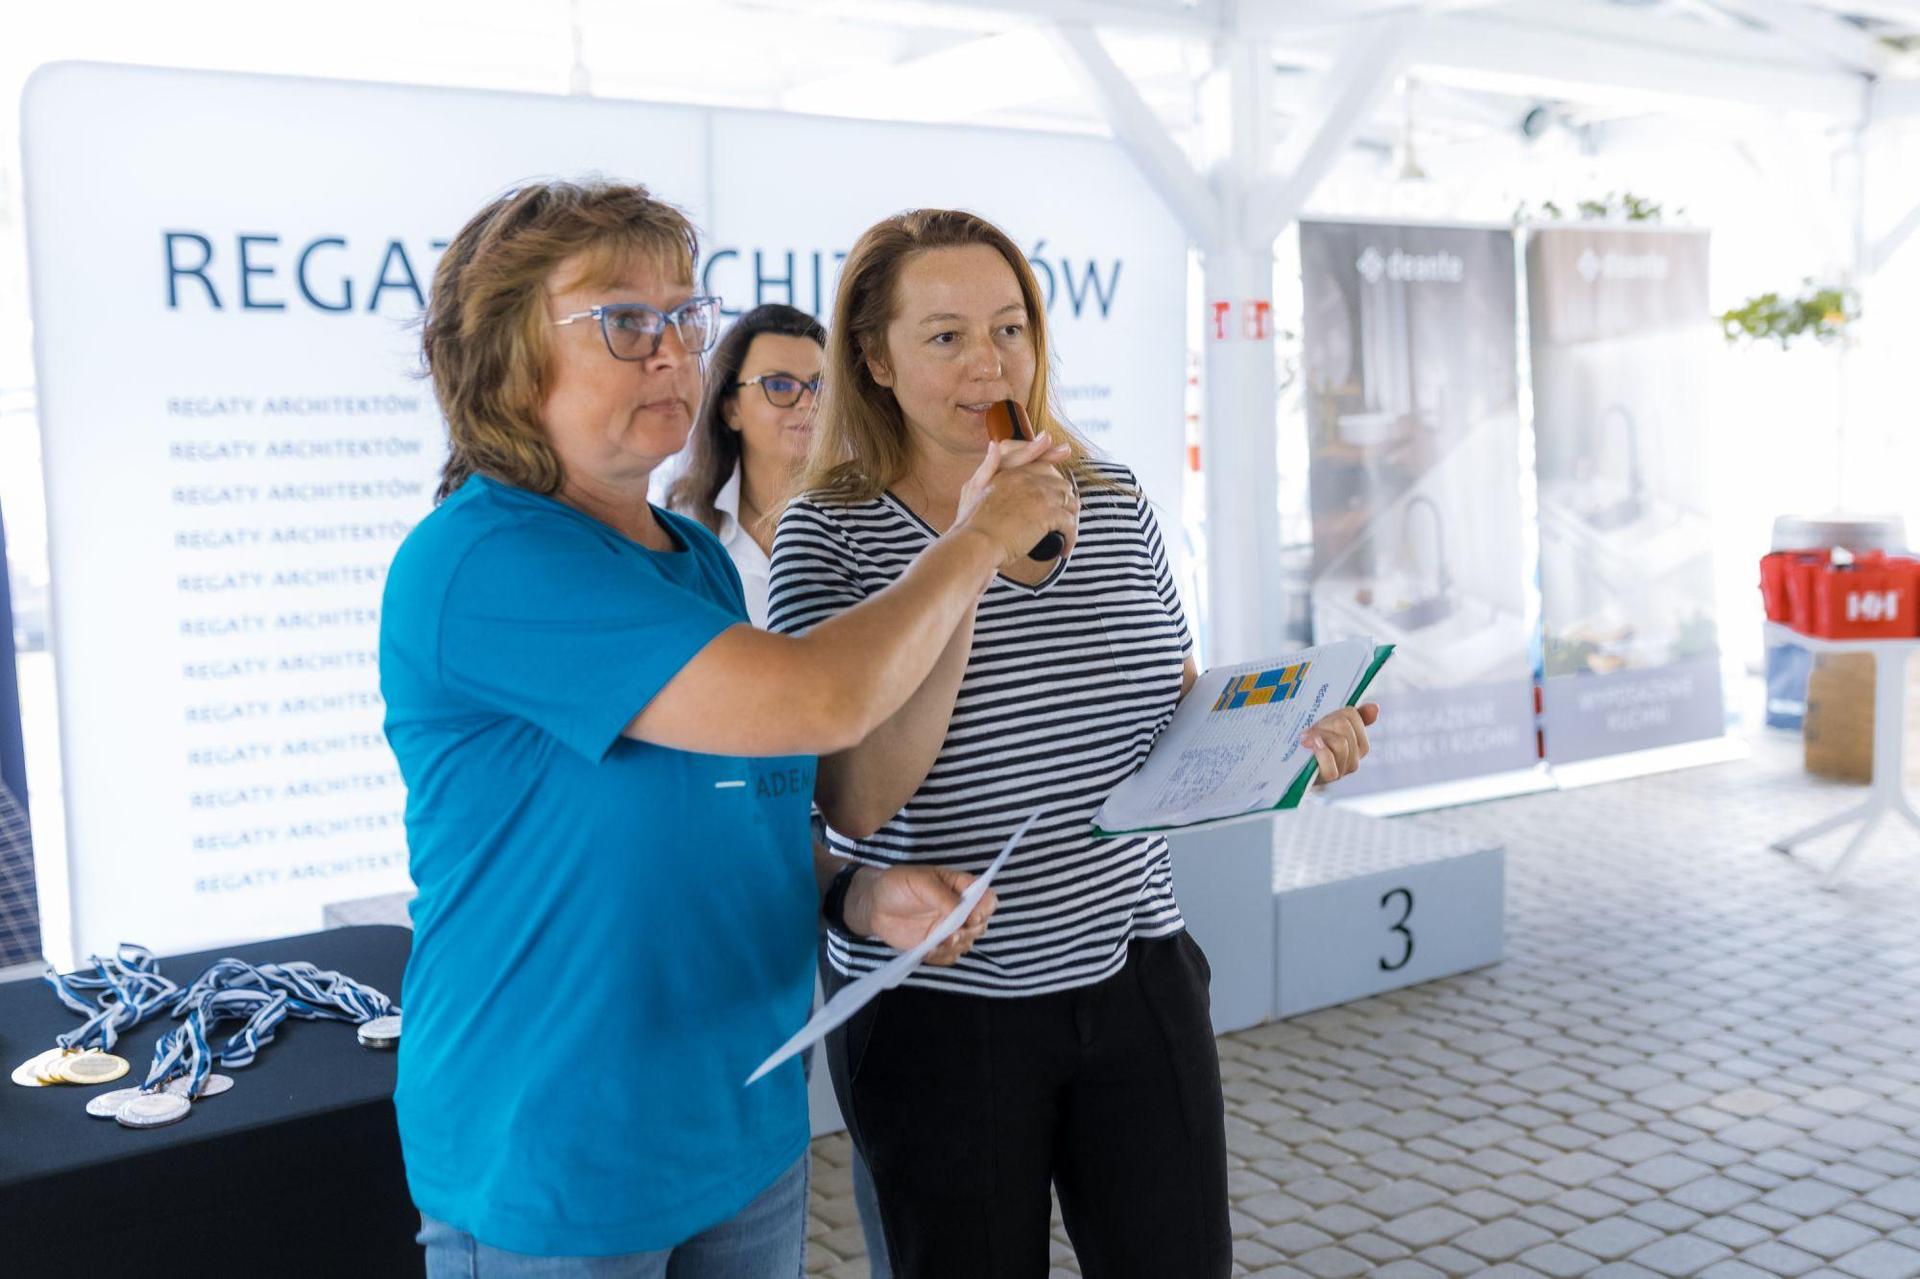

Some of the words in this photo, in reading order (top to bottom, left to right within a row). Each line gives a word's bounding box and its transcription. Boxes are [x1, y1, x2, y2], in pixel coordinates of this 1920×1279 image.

[163, 231, 448, 312] REGA
[167, 396, 254, 416] REGATY
[169, 440, 256, 461] REGATY
[172, 484, 259, 505] REGATY
[175, 528, 261, 549] REGATY
[177, 572, 263, 593] REGATY
[179, 615, 265, 637] REGATY
[182, 660, 268, 681] REGATY
[184, 702, 270, 723] REGATY
[187, 744, 273, 767] REGATY
[189, 787, 275, 809] REGATY
[192, 829, 277, 852] REGATY
[194, 871, 280, 895] REGATY
[1379, 888, 1414, 971] 3
